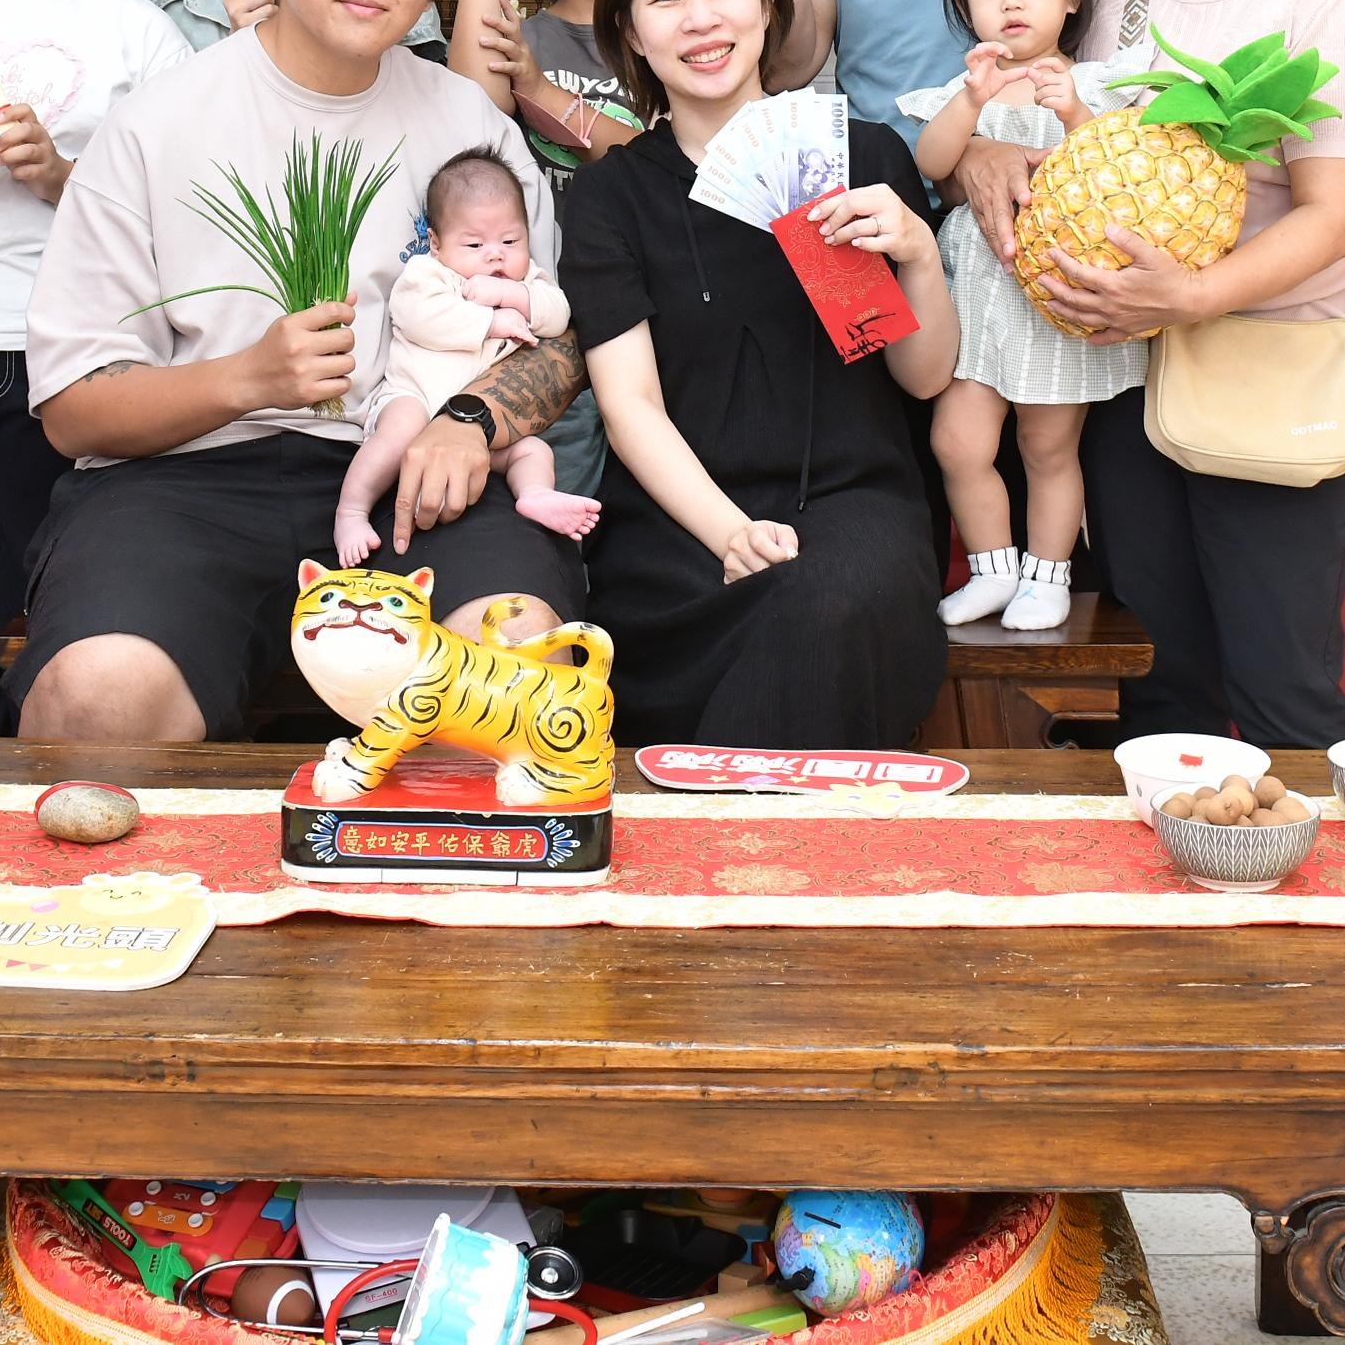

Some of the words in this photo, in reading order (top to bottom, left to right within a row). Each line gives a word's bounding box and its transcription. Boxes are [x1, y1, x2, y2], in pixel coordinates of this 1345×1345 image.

[832, 102, 844, 138] 1000
[103, 1216, 132, 1247] TOOLS
[364, 1287, 398, 1303] SF-400
